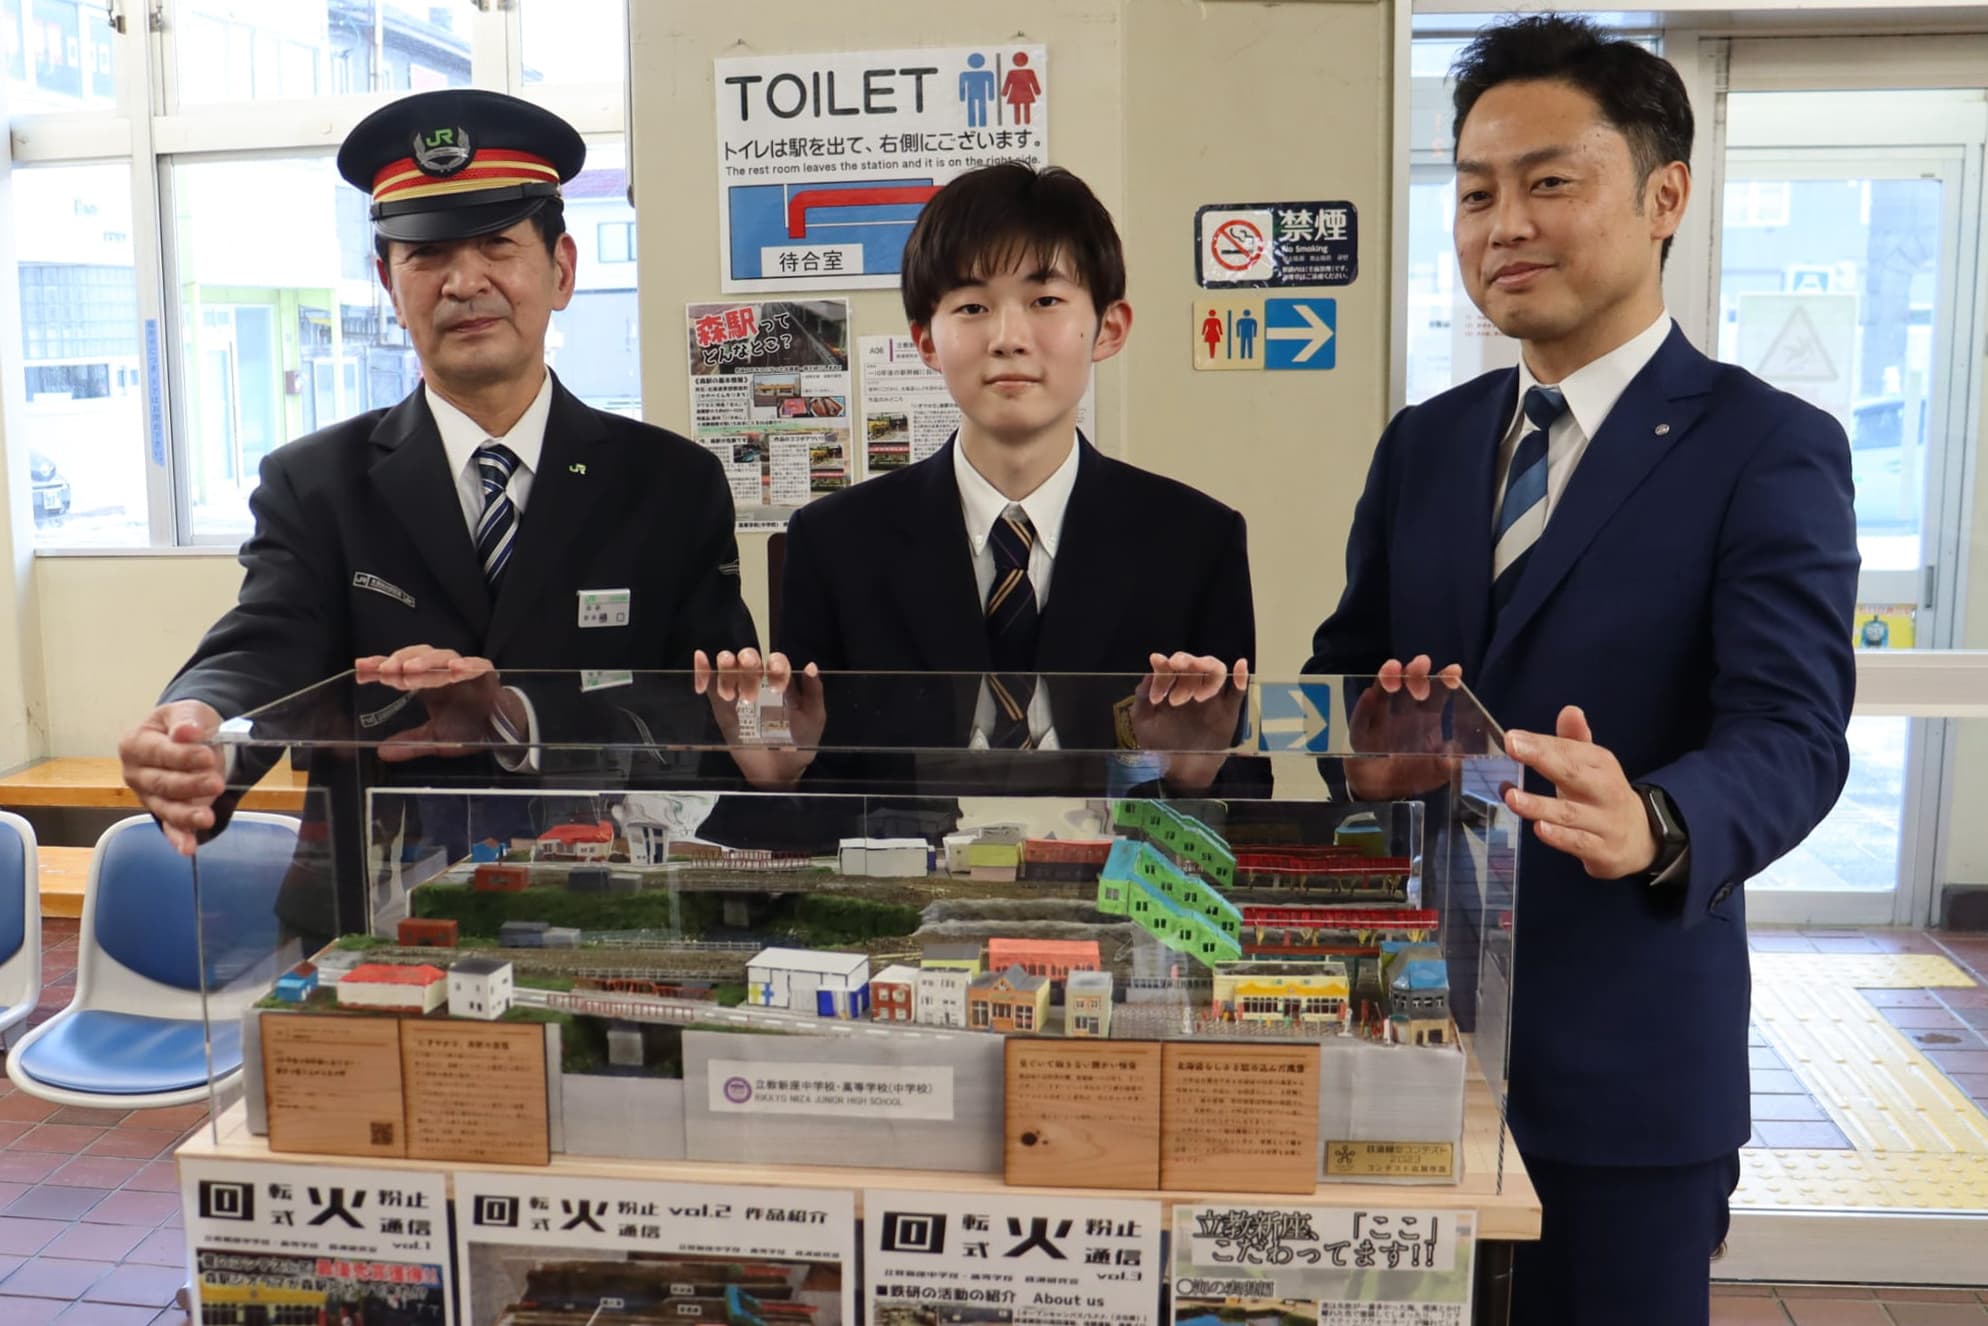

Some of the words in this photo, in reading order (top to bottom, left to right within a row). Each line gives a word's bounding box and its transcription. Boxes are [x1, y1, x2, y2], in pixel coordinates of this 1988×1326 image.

[725, 67, 939, 121] TOILET
[425, 128, 454, 147] JR
[725, 129, 1041, 160] トイレは駅を出て、右側にございます。
[726, 166, 745, 176] The
[749, 165, 769, 175] rest
[773, 165, 800, 175] room
[803, 162, 837, 173] leaves
[840, 161, 858, 171] the
[861, 159, 898, 170] station
[902, 157, 921, 168] and
[925, 157, 934, 167] it
[936, 157, 945, 167] is
[950, 158, 962, 166] on
[965, 156, 983, 166] the
[1278, 209, 1347, 242] 禁煙
[779, 250, 843, 273] 待合室
[1296, 245, 1329, 254] Smoking
[695, 306, 792, 348] 森駅って
[703, 334, 794, 367] どんなとこ?
[569, 463, 586, 475] JR
[268, 1183, 292, 1201] 転
[307, 1186, 367, 1230] 火
[529, 1197, 550, 1210] 転
[561, 1199, 608, 1233] 火
[668, 1203, 732, 1219] vol.2
[745, 1207, 828, 1225] 作品紹介
[270, 1209, 295, 1228] 式
[380, 1218, 432, 1237] 通信
[530, 1218, 550, 1232] 式
[618, 1223, 661, 1240] 通信
[962, 1213, 990, 1232] 転
[1003, 1216, 1074, 1260] 火
[962, 1240, 990, 1259] 式
[1084, 1247, 1143, 1267] 通信
[1033, 1292, 1081, 1306] About
[1087, 1296, 1104, 1307] us
